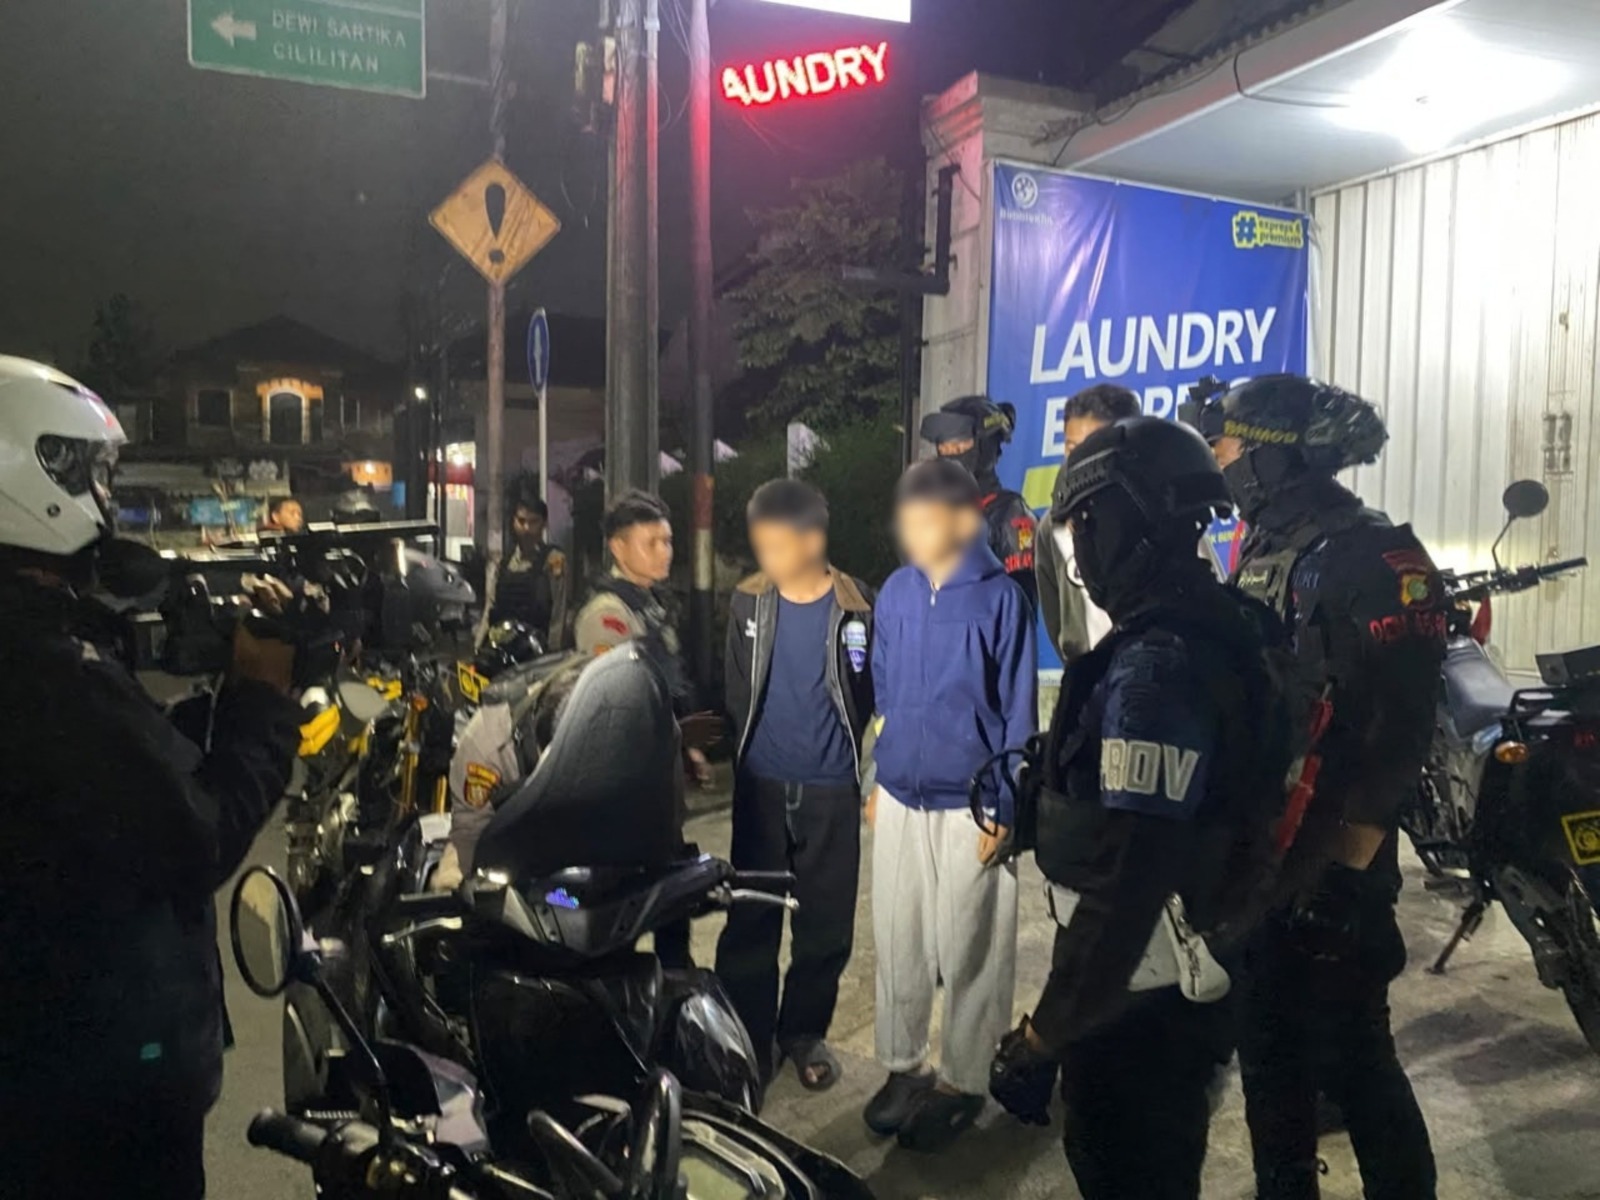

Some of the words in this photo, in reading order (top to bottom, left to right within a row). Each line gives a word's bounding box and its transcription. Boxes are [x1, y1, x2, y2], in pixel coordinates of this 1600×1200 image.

[272, 9, 317, 36] DEWI
[327, 18, 406, 49] SARTIKA
[273, 42, 379, 74] CILILITAN
[1030, 307, 1276, 384] LAUNDRY
[1100, 738, 1201, 802] ROV
